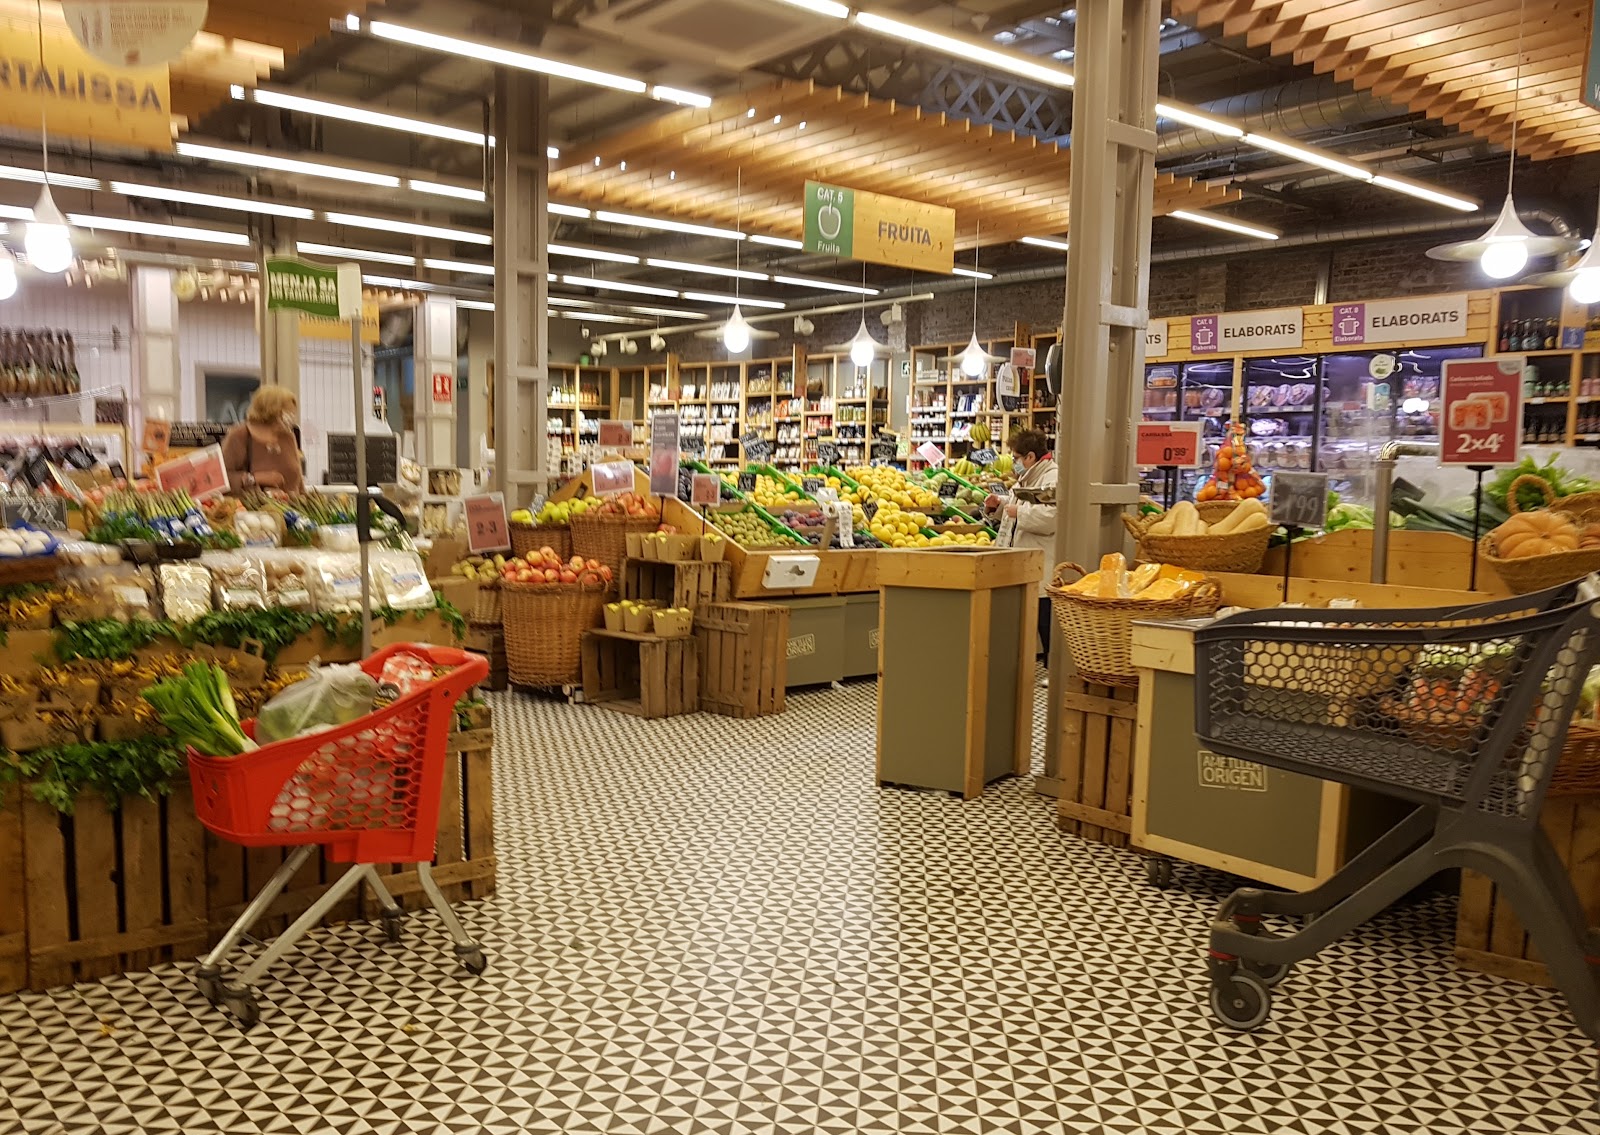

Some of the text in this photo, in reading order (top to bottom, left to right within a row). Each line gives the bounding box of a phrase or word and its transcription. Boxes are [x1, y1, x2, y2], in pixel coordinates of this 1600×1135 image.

[878, 219, 931, 246] FRUITA
[817, 240, 841, 255] Fruita
[1339, 307, 1353, 315] CAT.
[1372, 311, 1459, 328] ELABORATS
[1224, 323, 1296, 339] ELABORATS
[1334, 335, 1363, 343] Elaborats
[1203, 767, 1263, 786] ORIGEN
